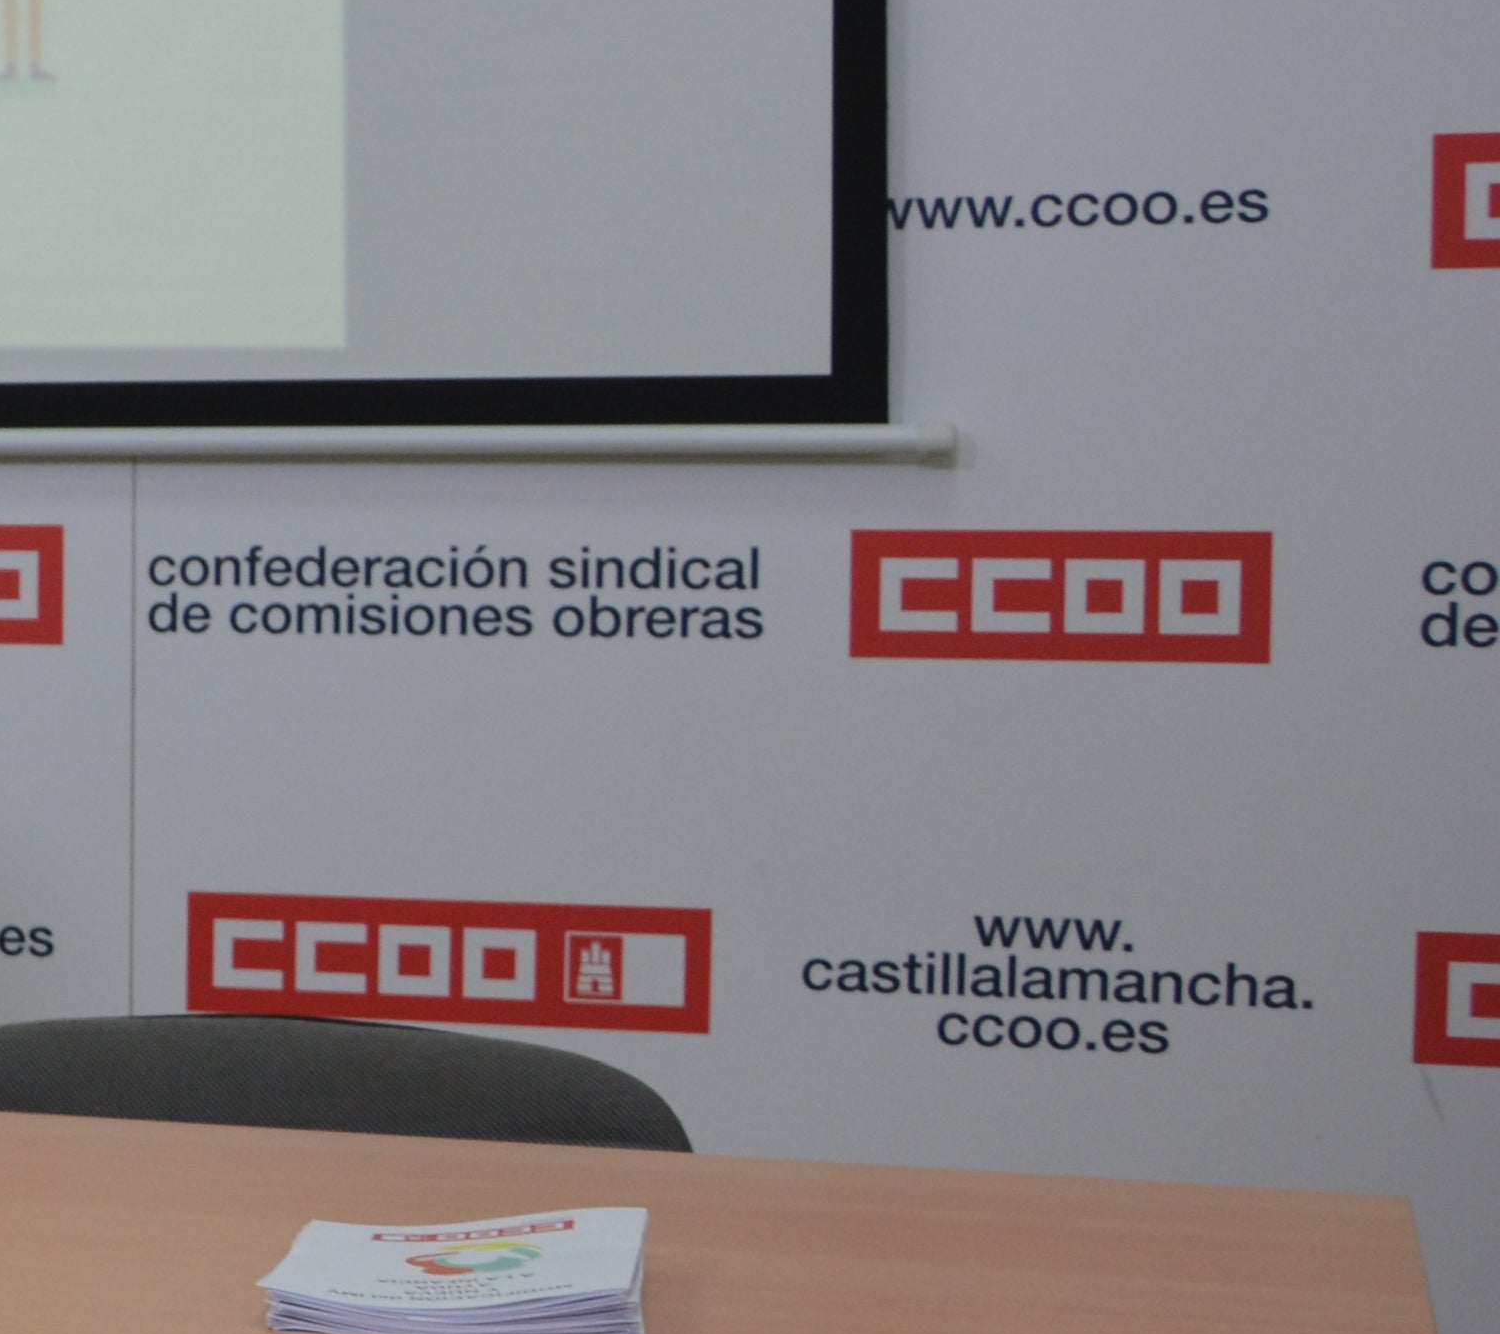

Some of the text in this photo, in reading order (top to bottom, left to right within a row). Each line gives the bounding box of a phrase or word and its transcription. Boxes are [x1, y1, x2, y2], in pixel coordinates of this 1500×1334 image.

[148, 544, 759, 591] confederación sindical
[147, 591, 764, 640] de comisiones obreras
[879, 558, 1241, 635] CCOO
[1420, 601, 1500, 649] de
[973, 915, 1134, 953] www.
[213, 918, 536, 1001] CCOO
[802, 951, 1314, 1010] castillalamancha.
[936, 1012, 1170, 1055] ccoo.es
